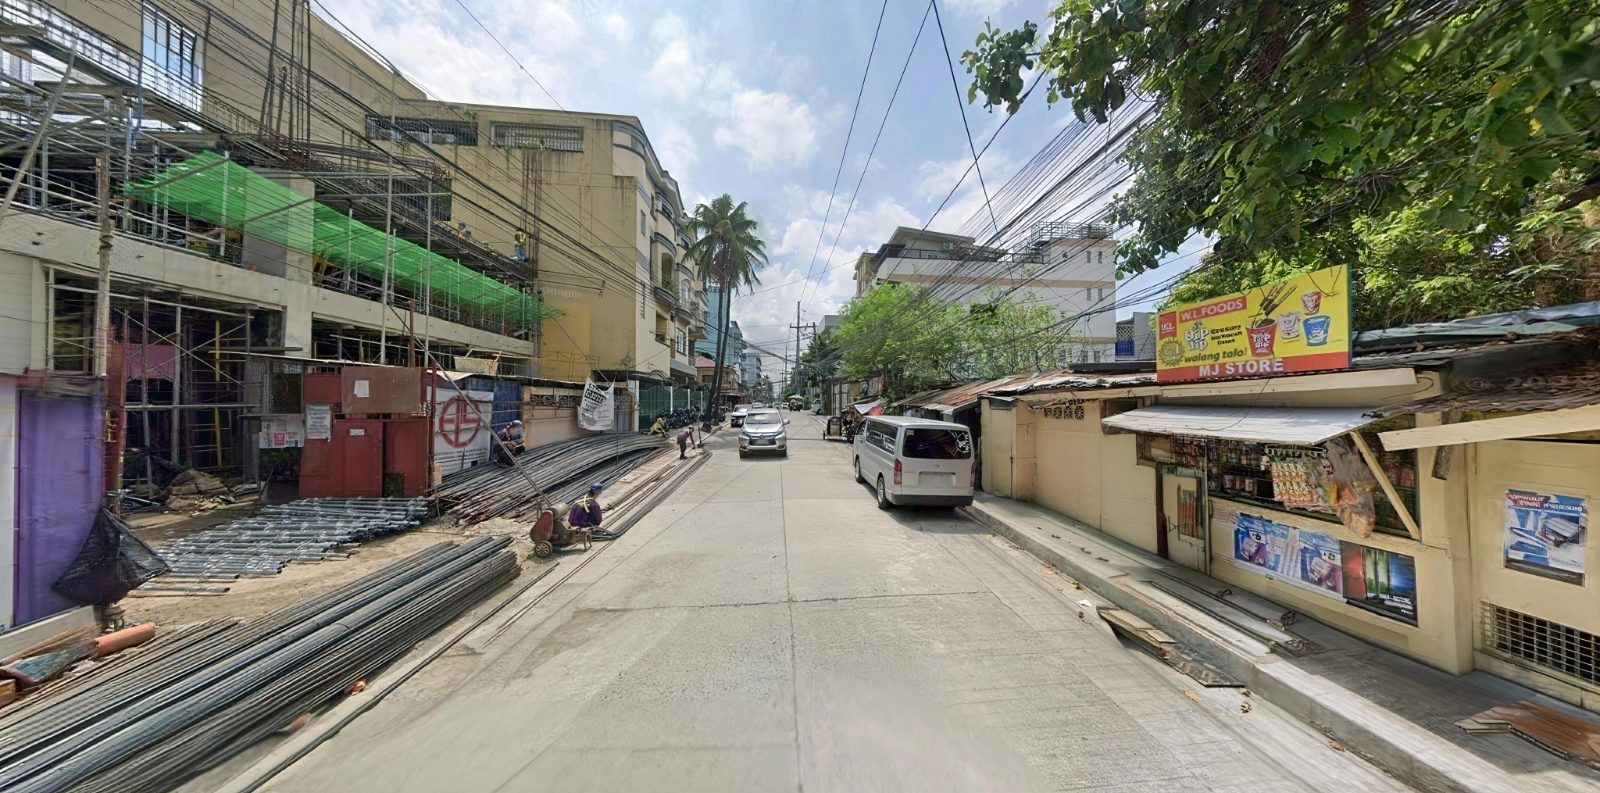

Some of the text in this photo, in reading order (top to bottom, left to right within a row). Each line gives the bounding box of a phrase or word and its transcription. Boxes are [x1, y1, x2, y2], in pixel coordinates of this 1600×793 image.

[1184, 347, 1247, 362] walang talo!
[1199, 358, 1284, 377] MJ STORE
